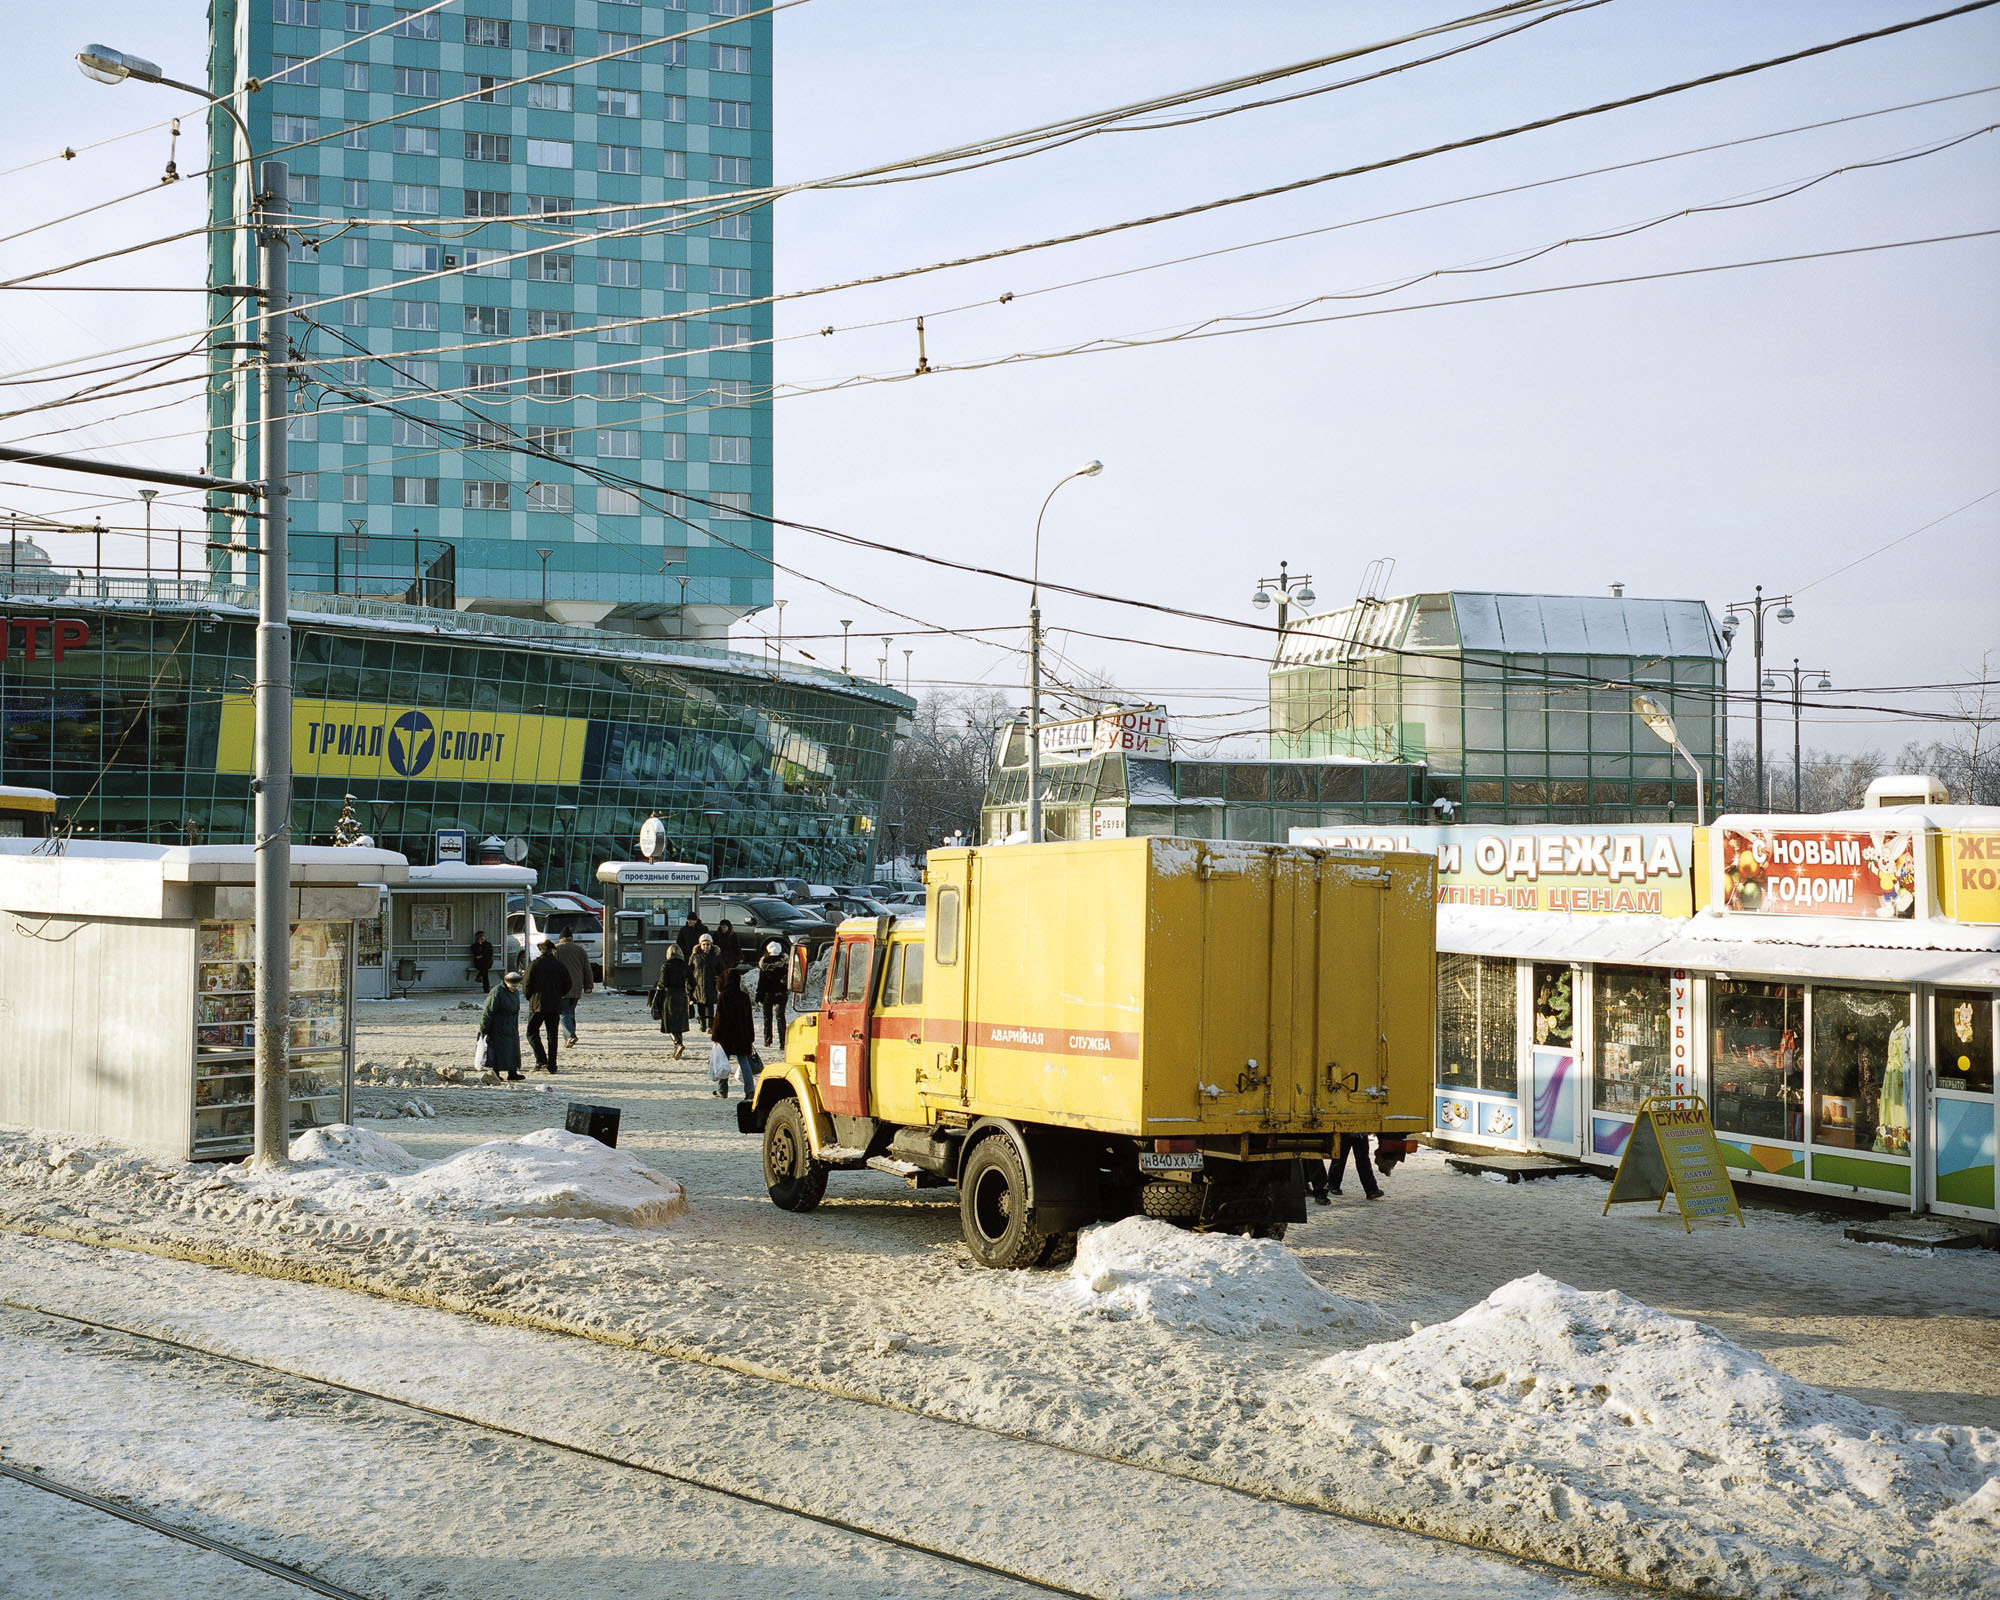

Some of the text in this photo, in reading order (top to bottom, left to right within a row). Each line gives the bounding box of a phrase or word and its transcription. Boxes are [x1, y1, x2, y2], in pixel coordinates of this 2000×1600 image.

[0, 616, 90, 663] ТР
[308, 722, 505, 762] ТРИАЛ СПОРТ
[1043, 723, 1088, 748] СТЕКЛО
[1475, 834, 1682, 883] ОДЕЖДА
[1752, 839, 1861, 866] С НОВЫМ
[625, 872, 700, 882] проездные билеты
[1961, 867, 2000, 890] КО
[1548, 886, 1662, 913] ЦЕНАМ
[1767, 876, 1854, 907] ГОДОМ!
[991, 1028, 1110, 1051] АВАРИЙНАЯ СЛУЖБА
[1674, 968, 1685, 1110] ФУТБОЛКИ
[1655, 1111, 1705, 1126] СУМКИ
[1664, 1128, 1705, 1138] КОШЕЛЬКИ
[1684, 1169, 1713, 1179] ПЛАТКИ
[1686, 1196, 1729, 1208] ДОМАШНЯЯ
[1694, 1207, 1727, 1217] ОДЕЖДА
